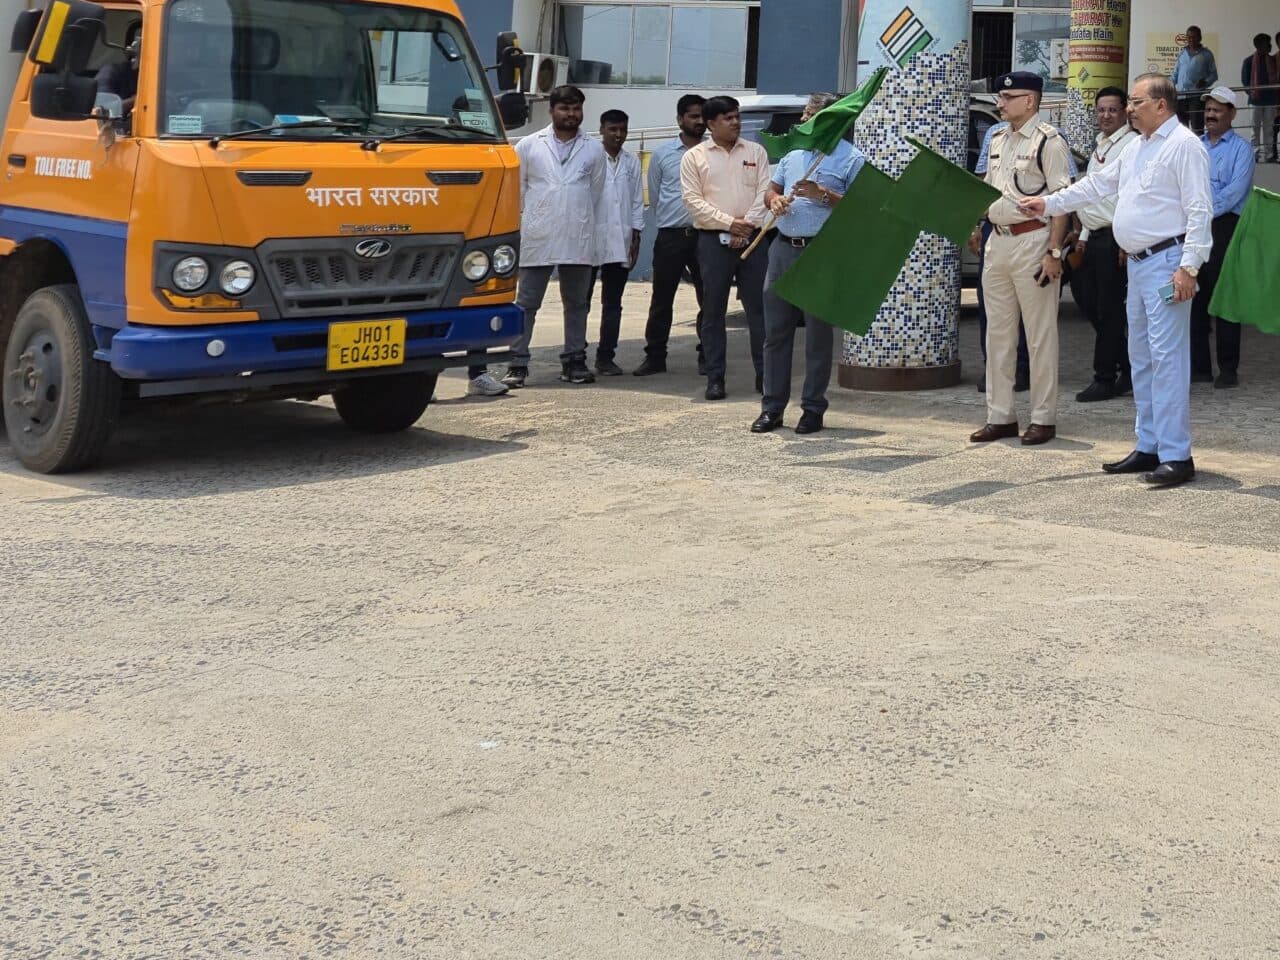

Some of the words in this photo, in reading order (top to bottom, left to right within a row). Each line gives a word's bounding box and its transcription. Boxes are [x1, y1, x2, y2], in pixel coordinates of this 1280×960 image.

[35, 156, 54, 176] TOLL
[55, 157, 76, 178] FREE
[305, 187, 362, 207] भारत
[368, 187, 440, 207] सरकार
[353, 325, 392, 344] JH01
